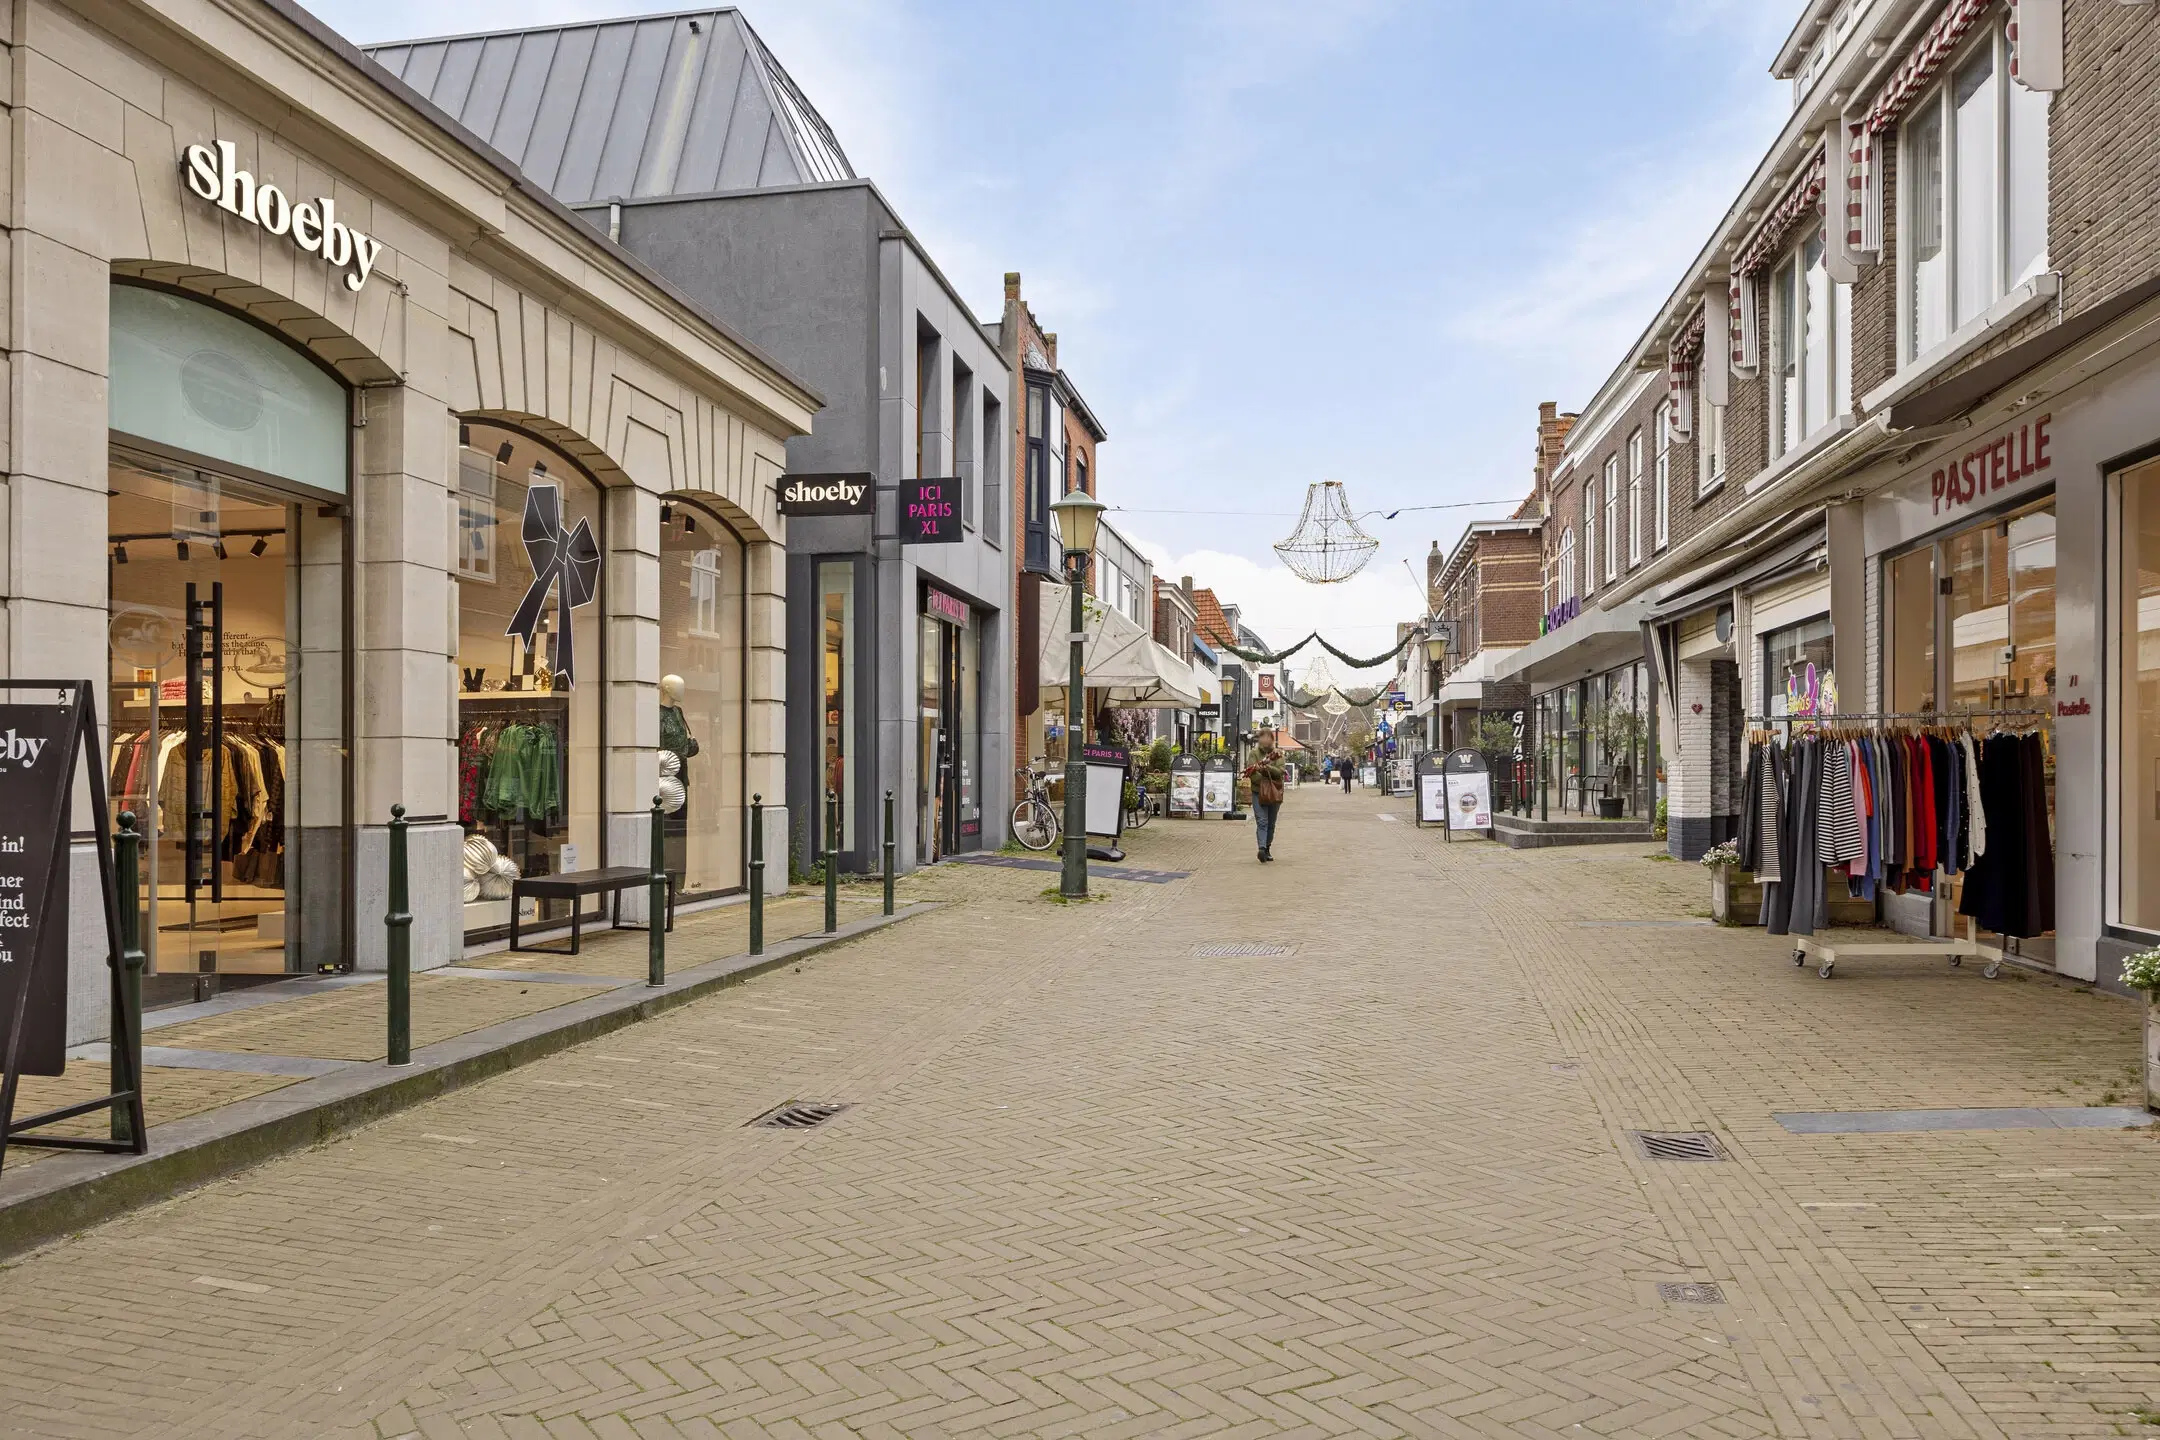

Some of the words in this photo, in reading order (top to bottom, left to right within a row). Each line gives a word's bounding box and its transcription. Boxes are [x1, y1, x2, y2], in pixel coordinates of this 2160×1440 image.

[185, 138, 383, 292] shoeby
[1931, 413, 2052, 516] PASTELLE
[784, 480, 868, 506] shoeby
[919, 486, 941, 500] ICI
[909, 503, 952, 518] PARIS
[921, 520, 940, 535] XL
[1091, 749, 1112, 758] PARIS
[1114, 751, 1124, 760] XL
[1, 835, 25, 853] in!
